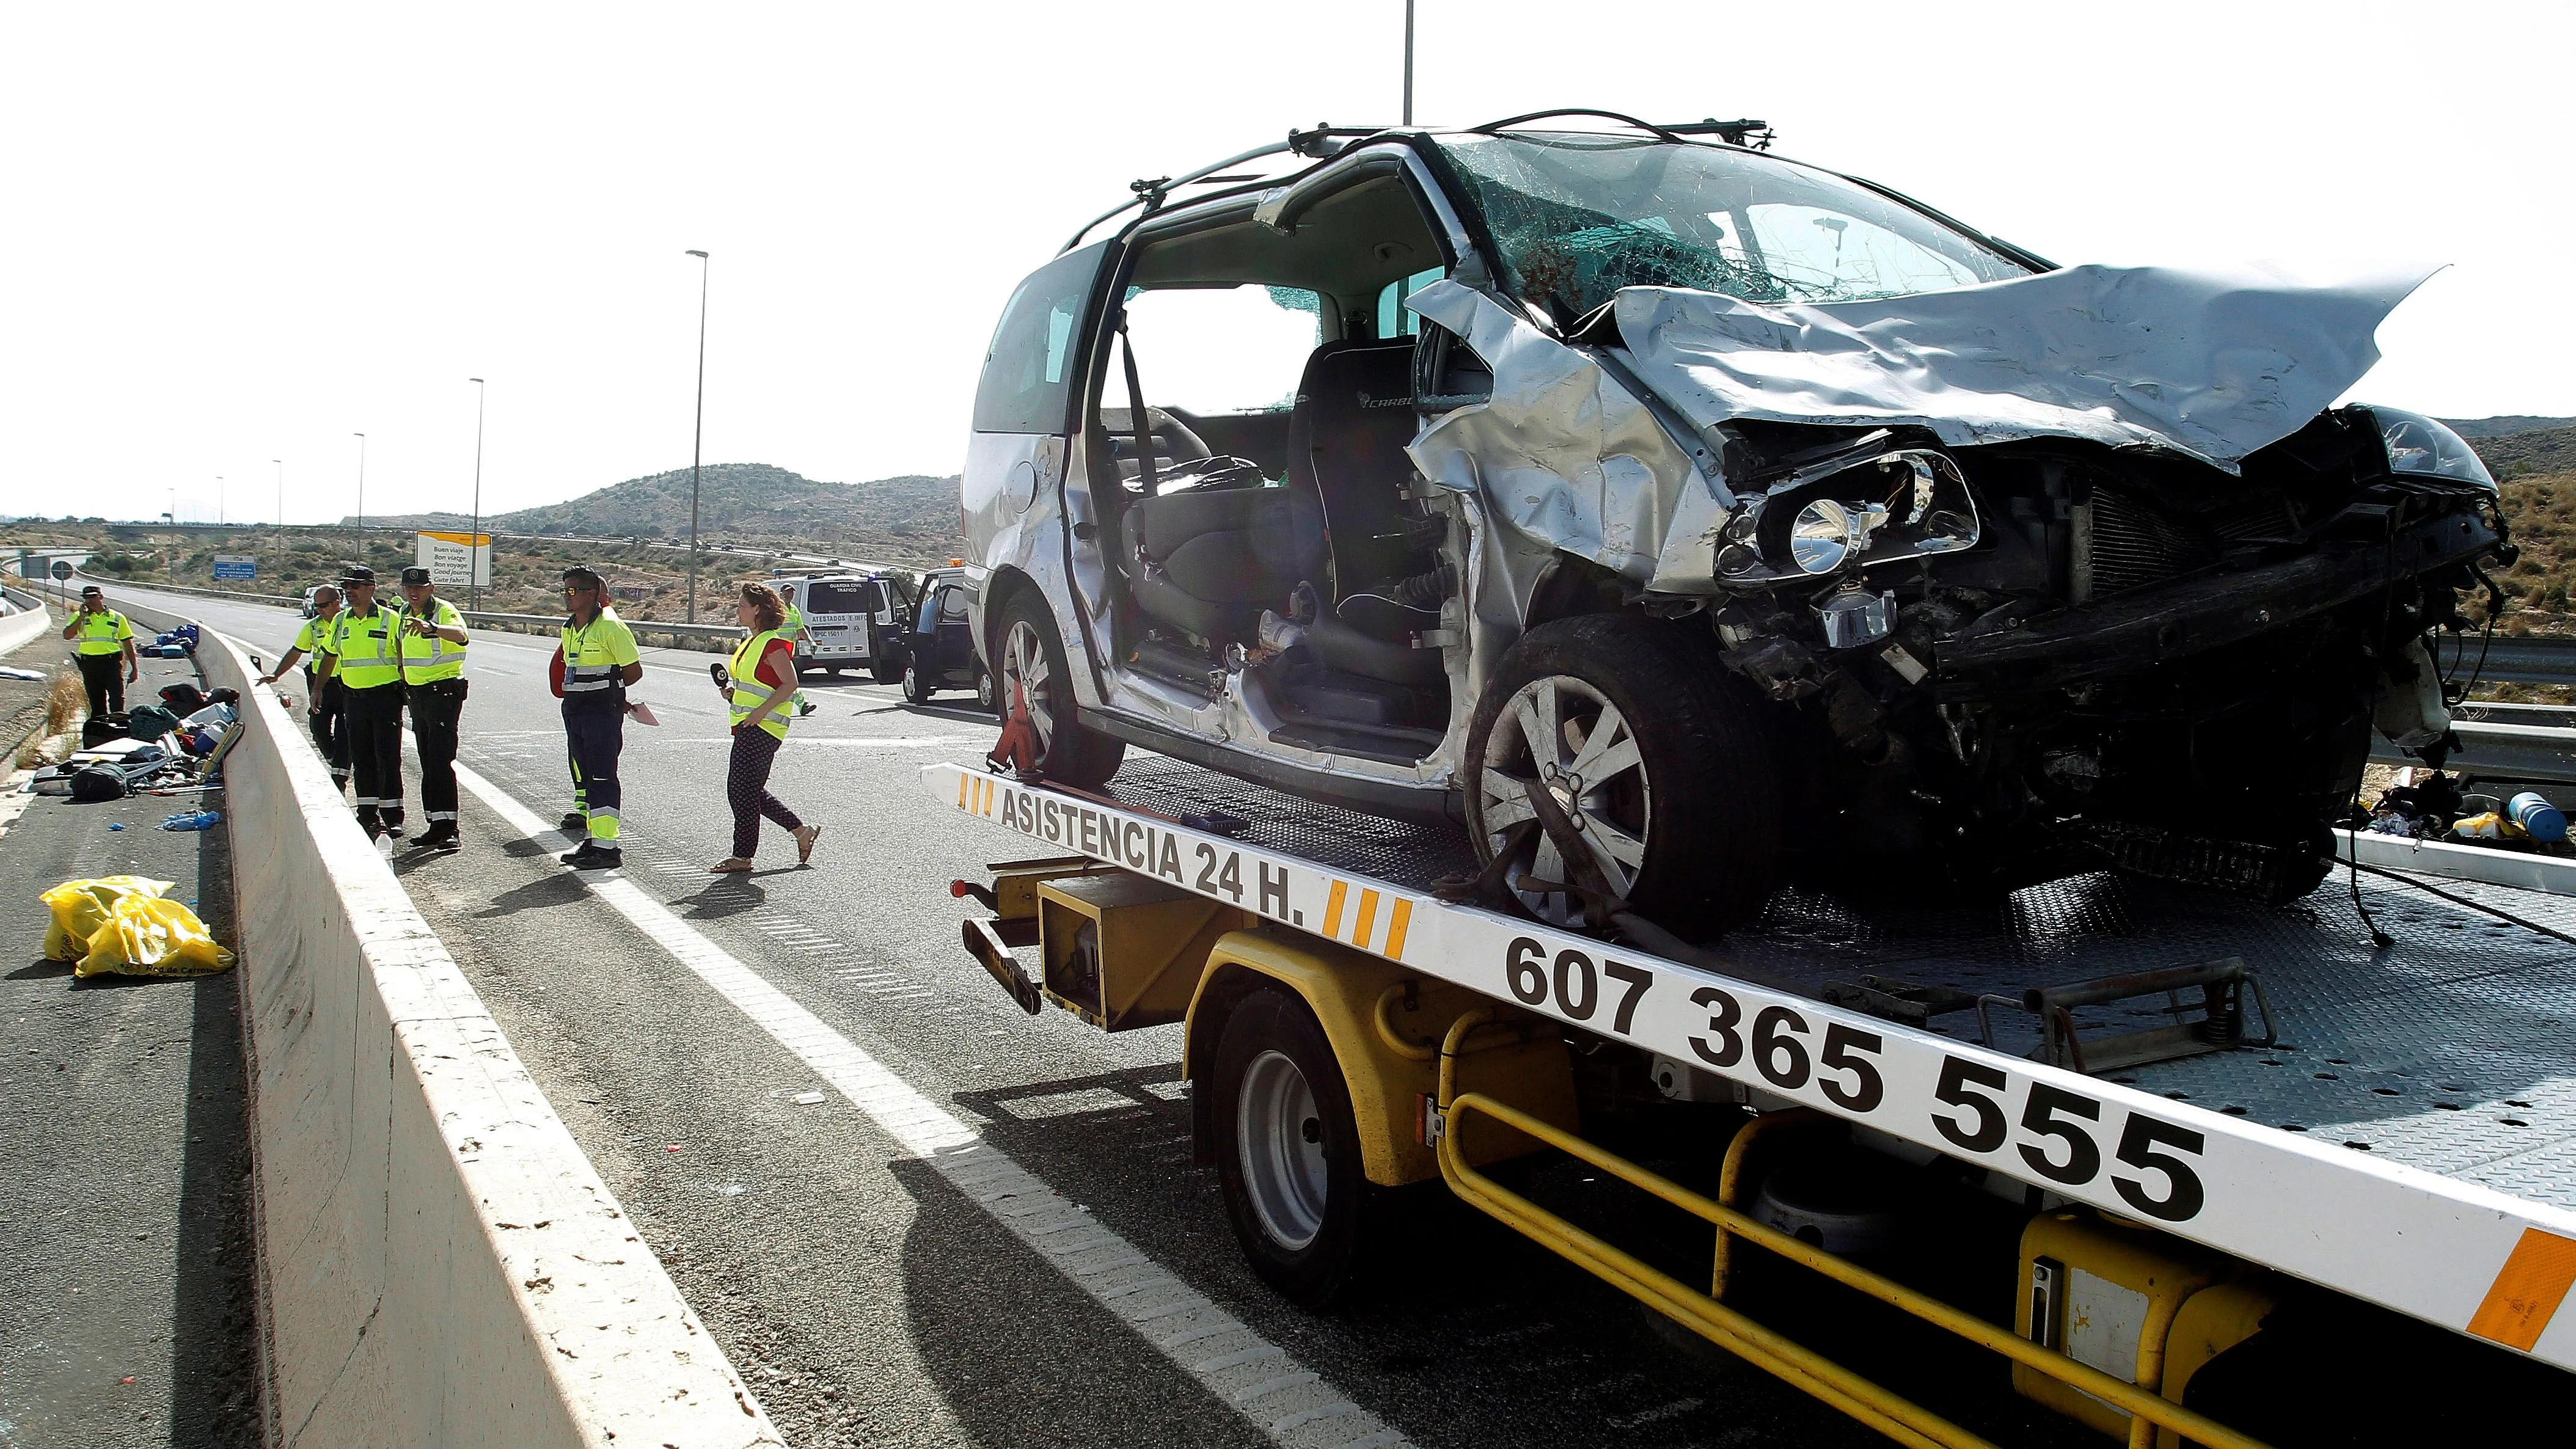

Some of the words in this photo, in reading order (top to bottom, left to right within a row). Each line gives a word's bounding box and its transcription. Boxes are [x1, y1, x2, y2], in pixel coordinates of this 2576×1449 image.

[1001, 788, 1184, 884] ASISTENCIA
[1195, 842, 1244, 904] 24
[1259, 860, 1304, 927] H.
[1505, 935, 1654, 1037] 607
[1686, 985, 1886, 1114] 365
[1930, 1054, 2206, 1224] 555
